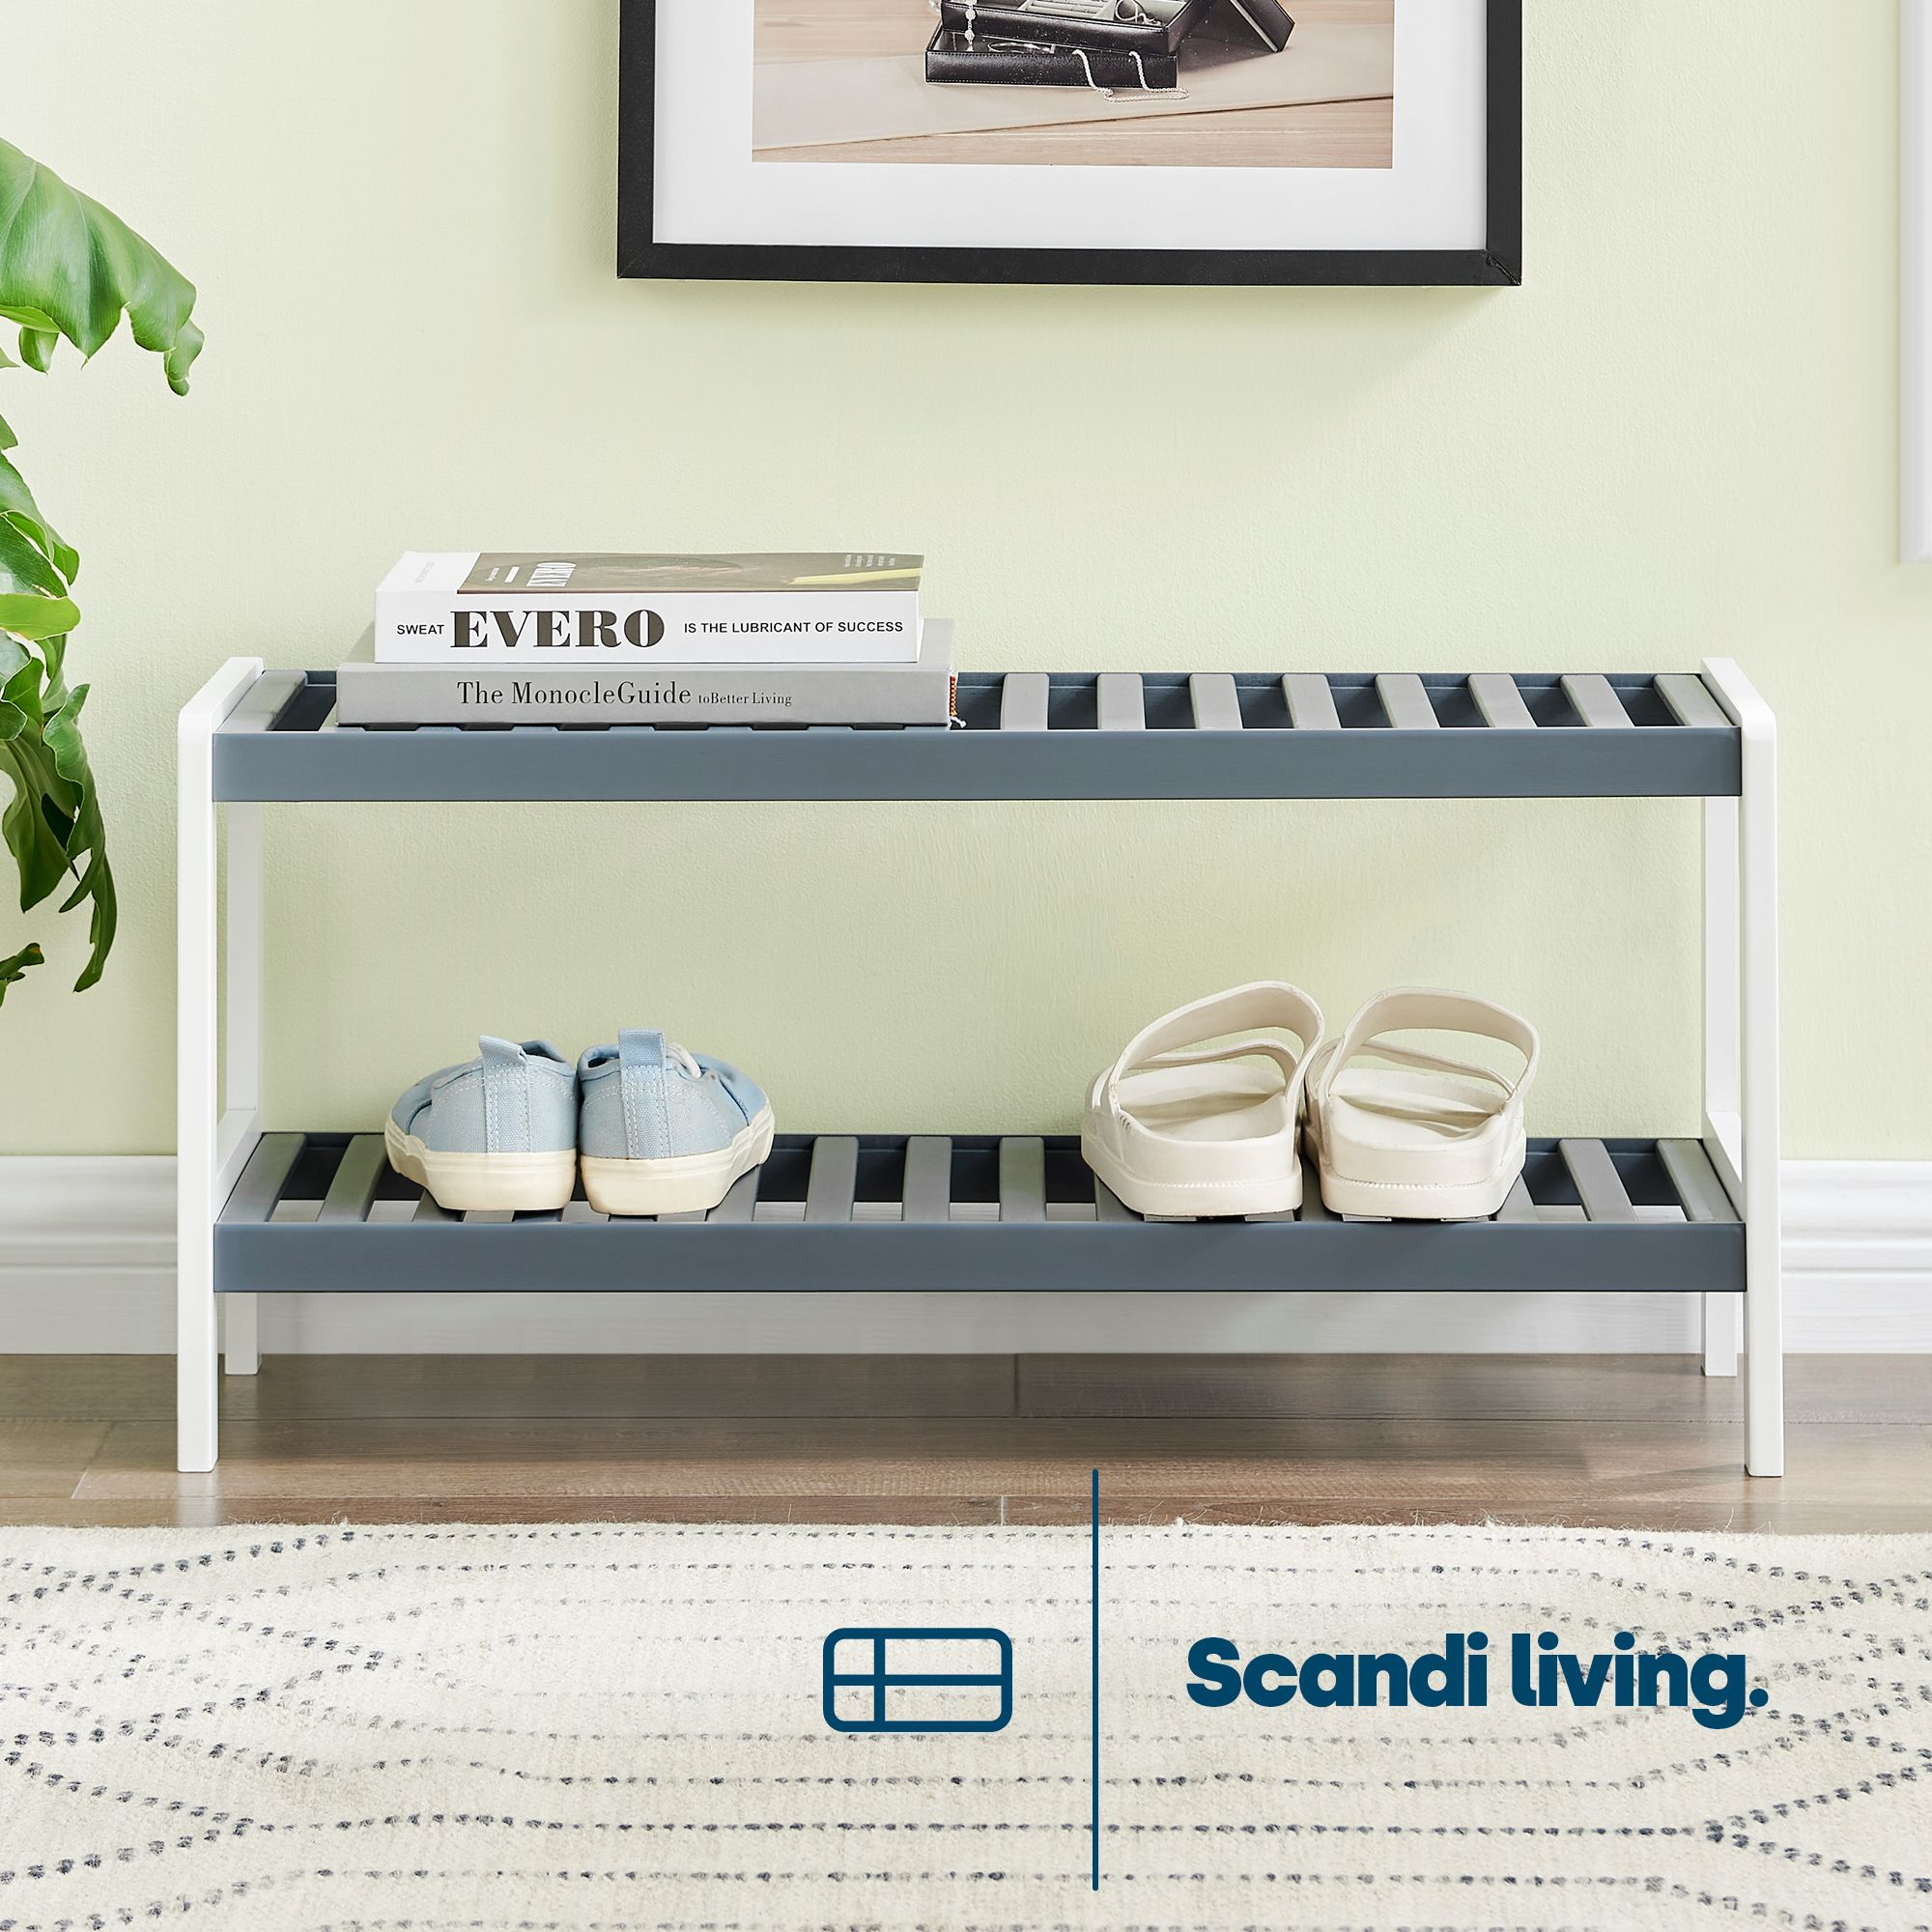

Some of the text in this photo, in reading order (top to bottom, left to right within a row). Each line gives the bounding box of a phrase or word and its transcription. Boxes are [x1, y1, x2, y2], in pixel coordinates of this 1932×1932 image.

[526, 561, 577, 586] EVERO
[397, 609, 903, 648] SWEAT EVERO IS THE LUBRICANT OF SUCCESS
[457, 681, 503, 704] The
[753, 692, 792, 707] Living
